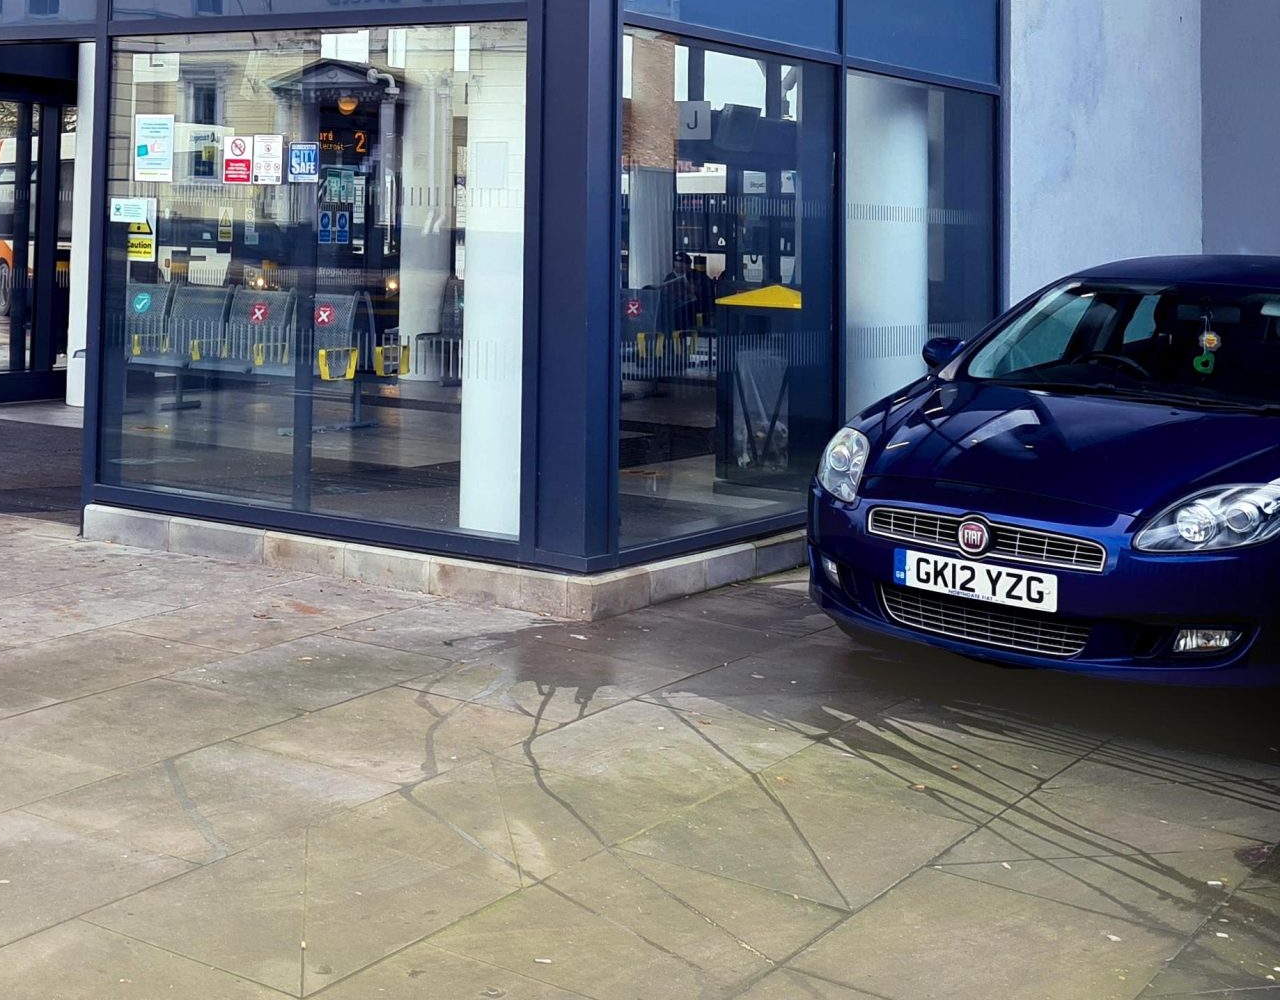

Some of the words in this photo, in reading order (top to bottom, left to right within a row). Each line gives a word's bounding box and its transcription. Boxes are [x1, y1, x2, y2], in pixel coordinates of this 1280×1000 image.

[687, 110, 698, 130] J
[354, 130, 367, 153] 2
[291, 161, 316, 174] SAFE
[964, 529, 982, 546] FIAT
[895, 570, 905, 579] GB
[916, 557, 976, 593] GK12
[985, 568, 1044, 604] YZG
